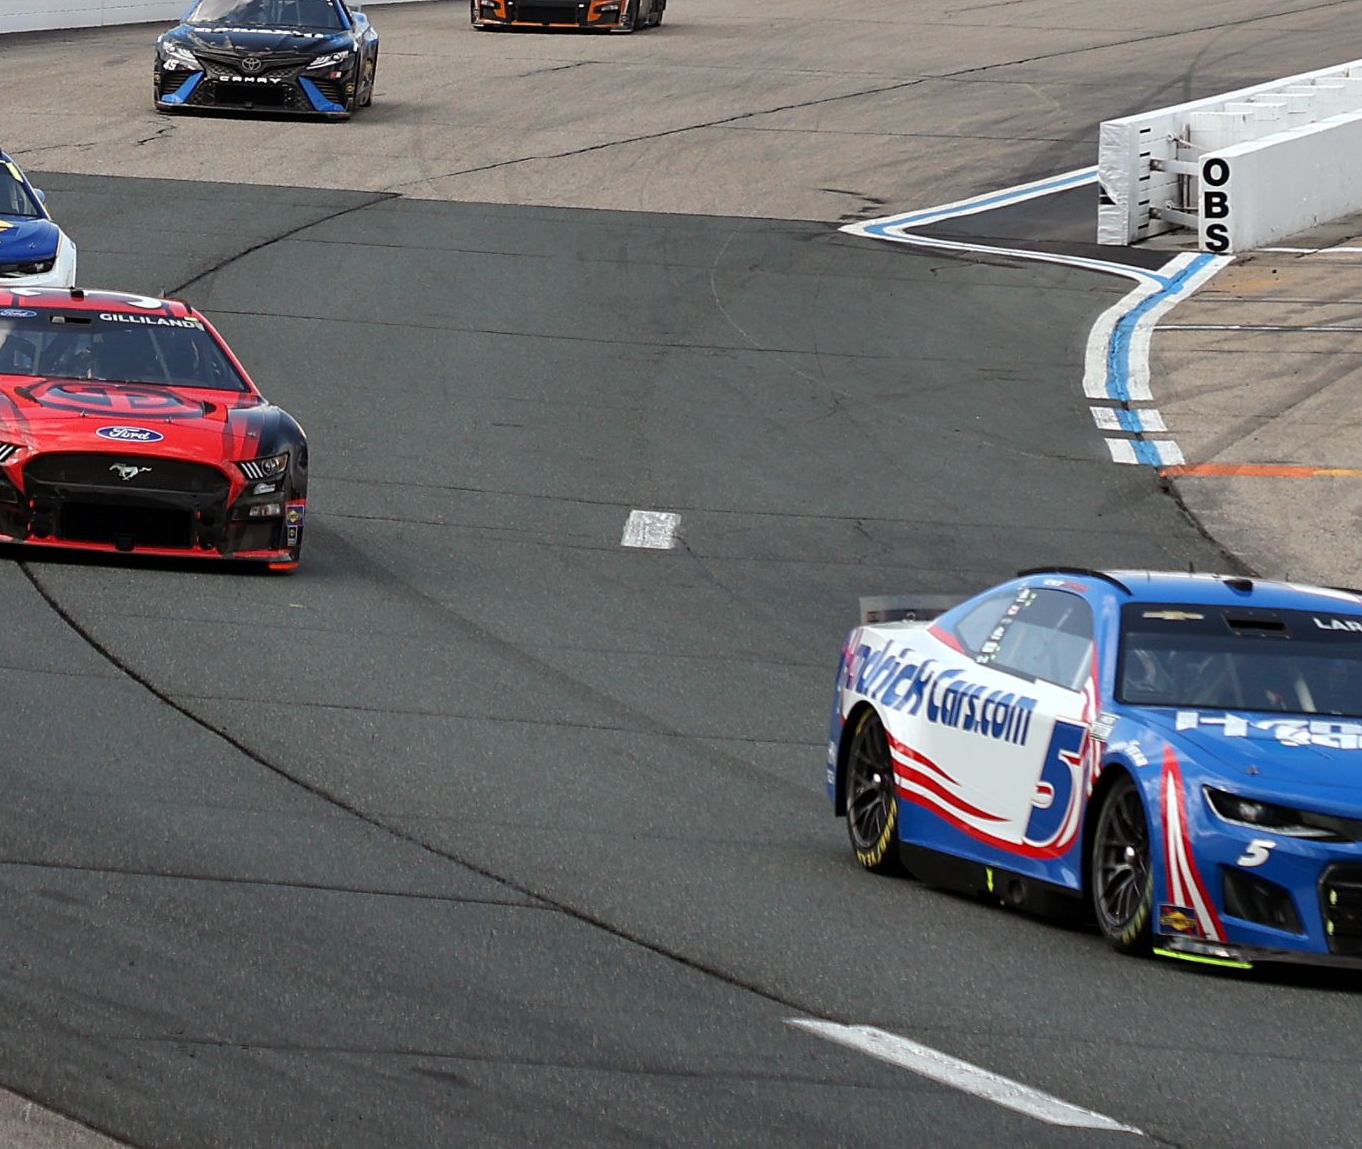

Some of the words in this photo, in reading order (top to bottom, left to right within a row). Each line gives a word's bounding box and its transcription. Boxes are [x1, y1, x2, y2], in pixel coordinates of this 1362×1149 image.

[1202, 157, 1230, 252] OBS
[99, 312, 198, 329] GILLILAND
[109, 426, 152, 441] Ford
[1024, 717, 1089, 848] 5
[1237, 839, 1277, 867] 5
